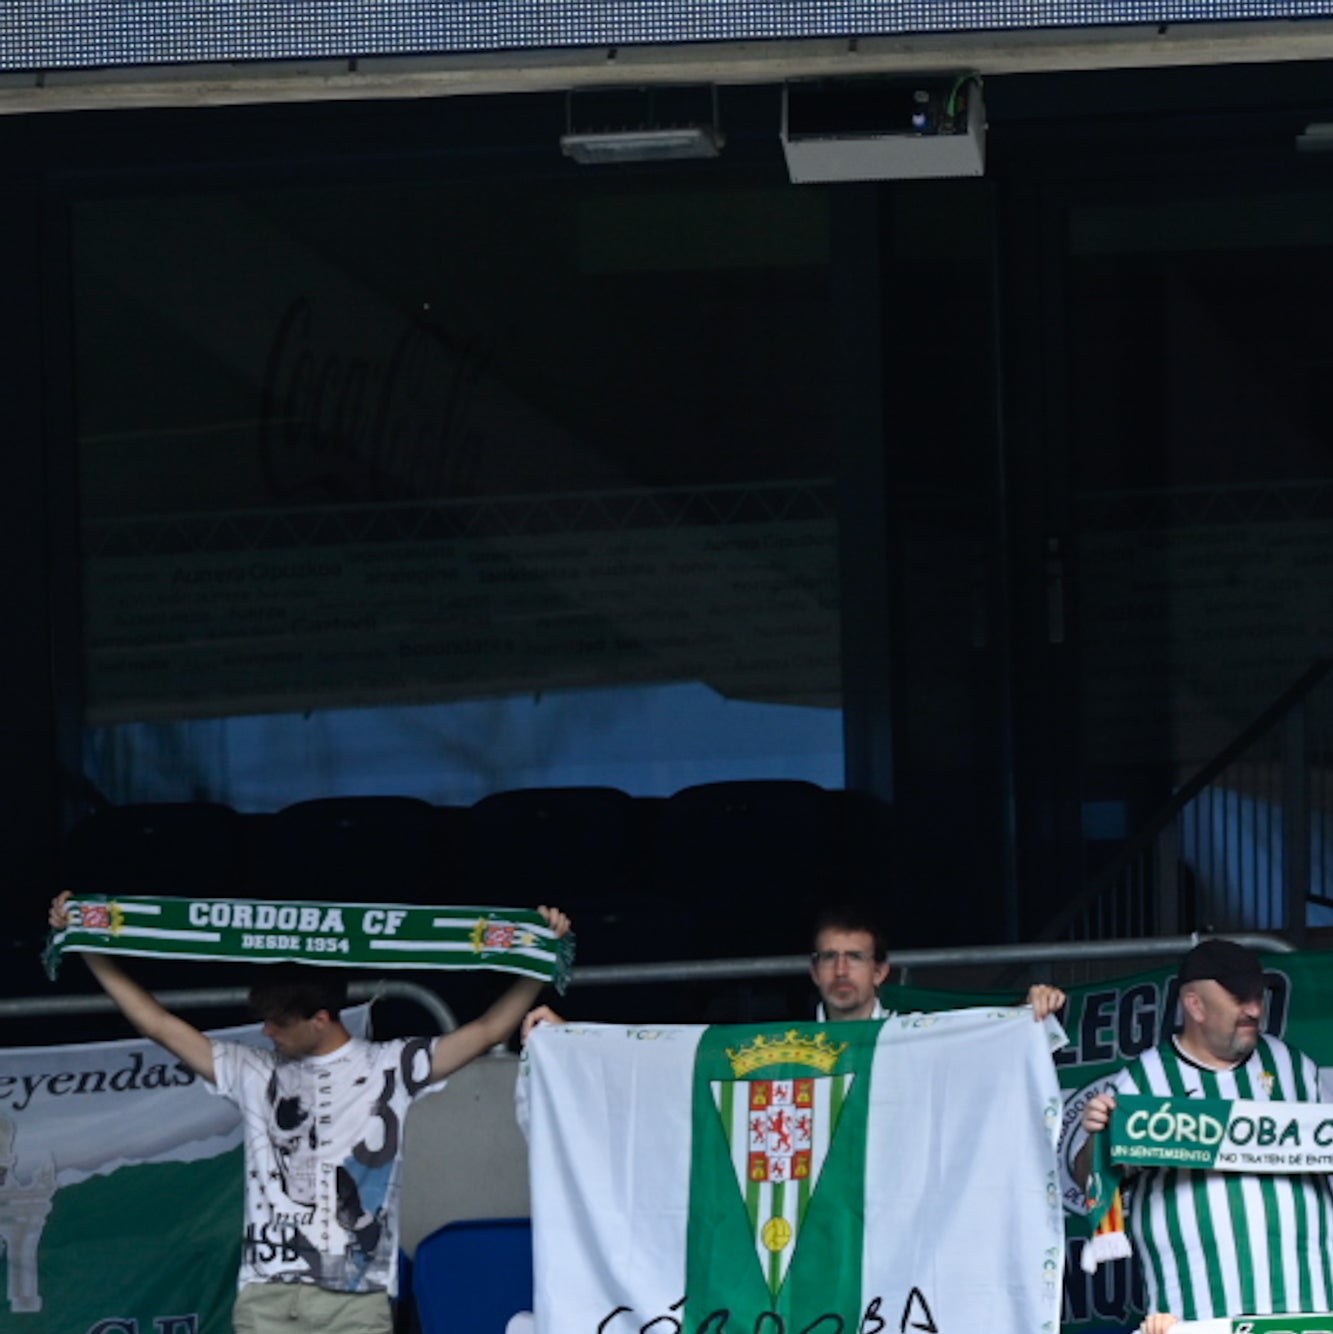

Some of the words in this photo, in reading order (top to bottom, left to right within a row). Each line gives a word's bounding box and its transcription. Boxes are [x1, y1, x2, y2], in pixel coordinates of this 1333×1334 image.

[363, 909, 406, 935] CF
[242, 934, 301, 952] DESDE
[305, 936, 349, 954] 1954
[1126, 1103, 1301, 1147] CÓRDOBA
[1220, 1153, 1238, 1164] NO
[1241, 1153, 1285, 1165] TRATEN
[1287, 1154, 1302, 1165] DE
